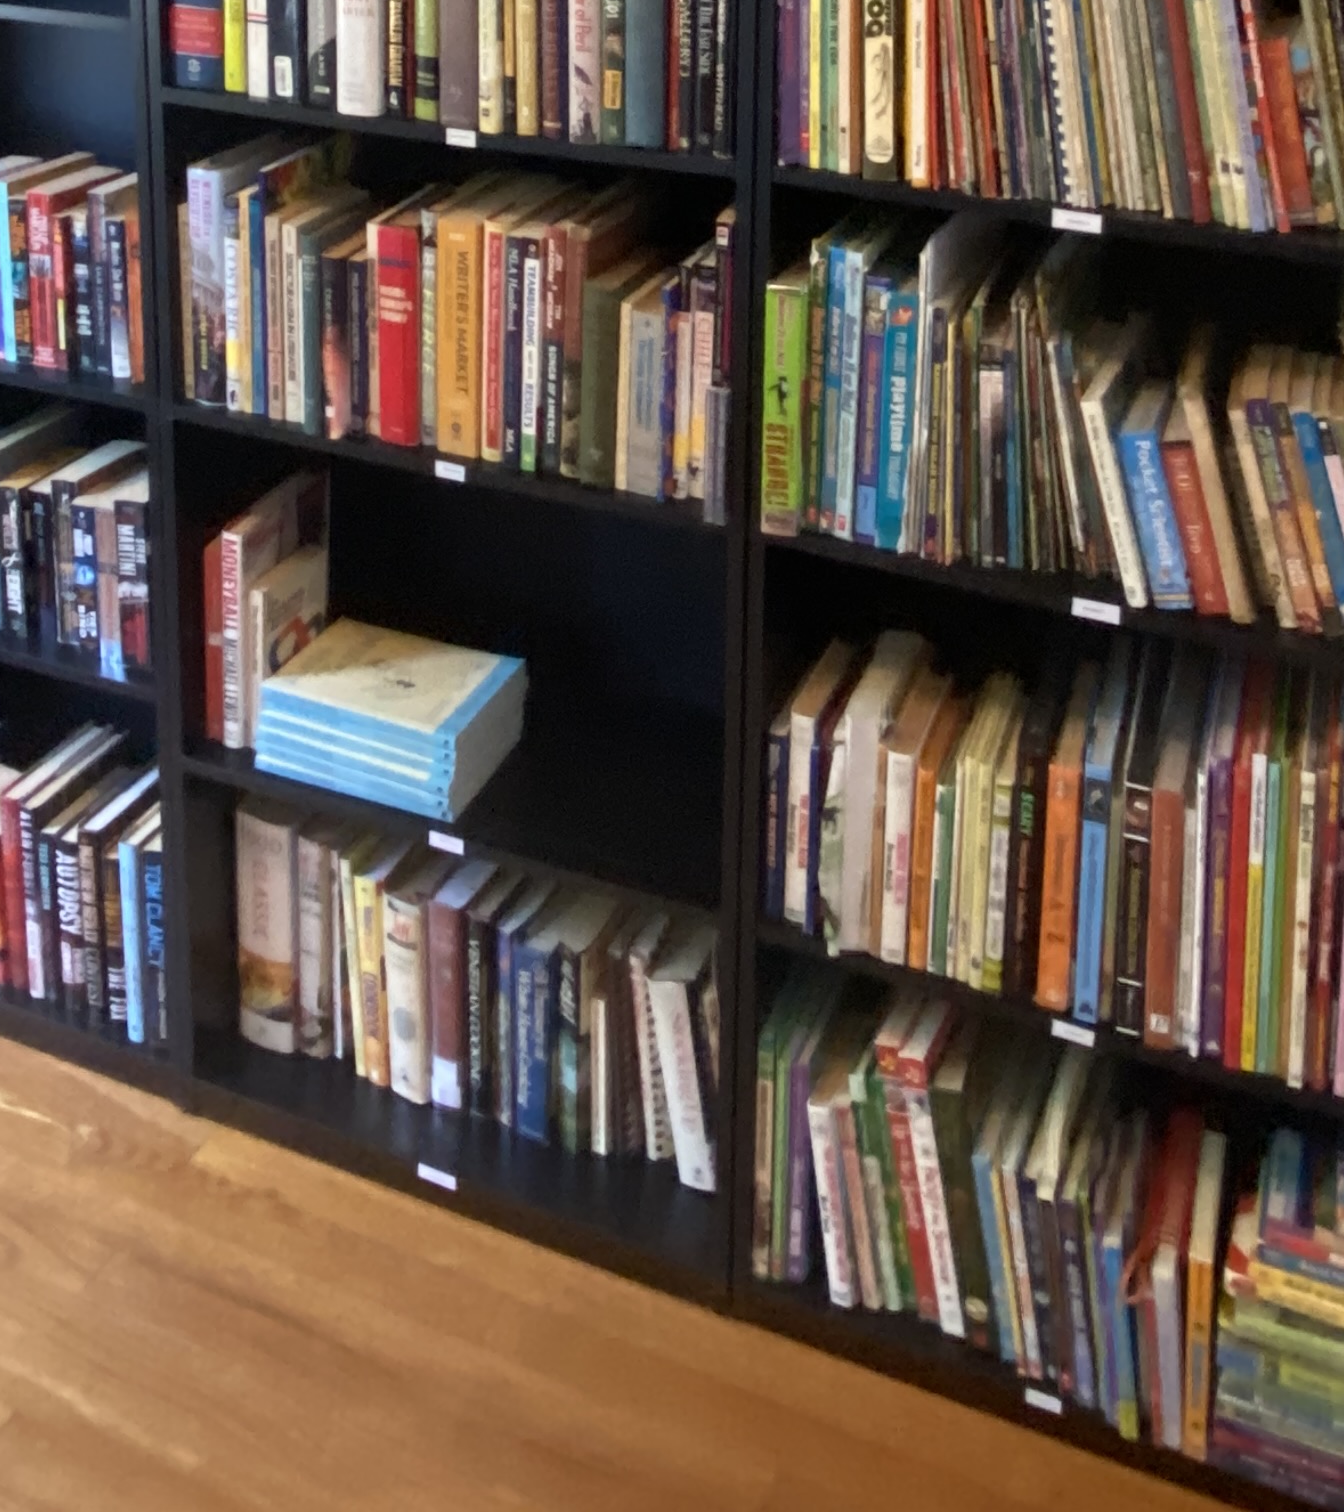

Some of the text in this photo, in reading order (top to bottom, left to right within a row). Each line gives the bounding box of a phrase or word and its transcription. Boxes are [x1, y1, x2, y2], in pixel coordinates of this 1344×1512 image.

[576, 9, 591, 22] of
[577, 25, 591, 53] Peril
[455, 251, 469, 395] WRITER'S MARKET
[506, 248, 519, 330] MLA Handbook
[523, 265, 536, 428] TEAMBUILDING RESULTS
[546, 345, 558, 445] SONGS OF AMERICA
[889, 375, 907, 452] playtime
[505, 428, 515, 452] MLA
[1135, 440, 1158, 496] Pocket
[117, 524, 136, 575] MARTINI
[223, 539, 239, 630] MONEYBALL
[20, 810, 33, 848] ALAN
[56, 849, 80, 934] AUTOPSY
[145, 864, 164, 970] TOM CLANCY
[252, 861, 268, 940] CLASSIC
[109, 966, 125, 1021] THE FOX
[468, 939, 479, 1013] VENETIAN
